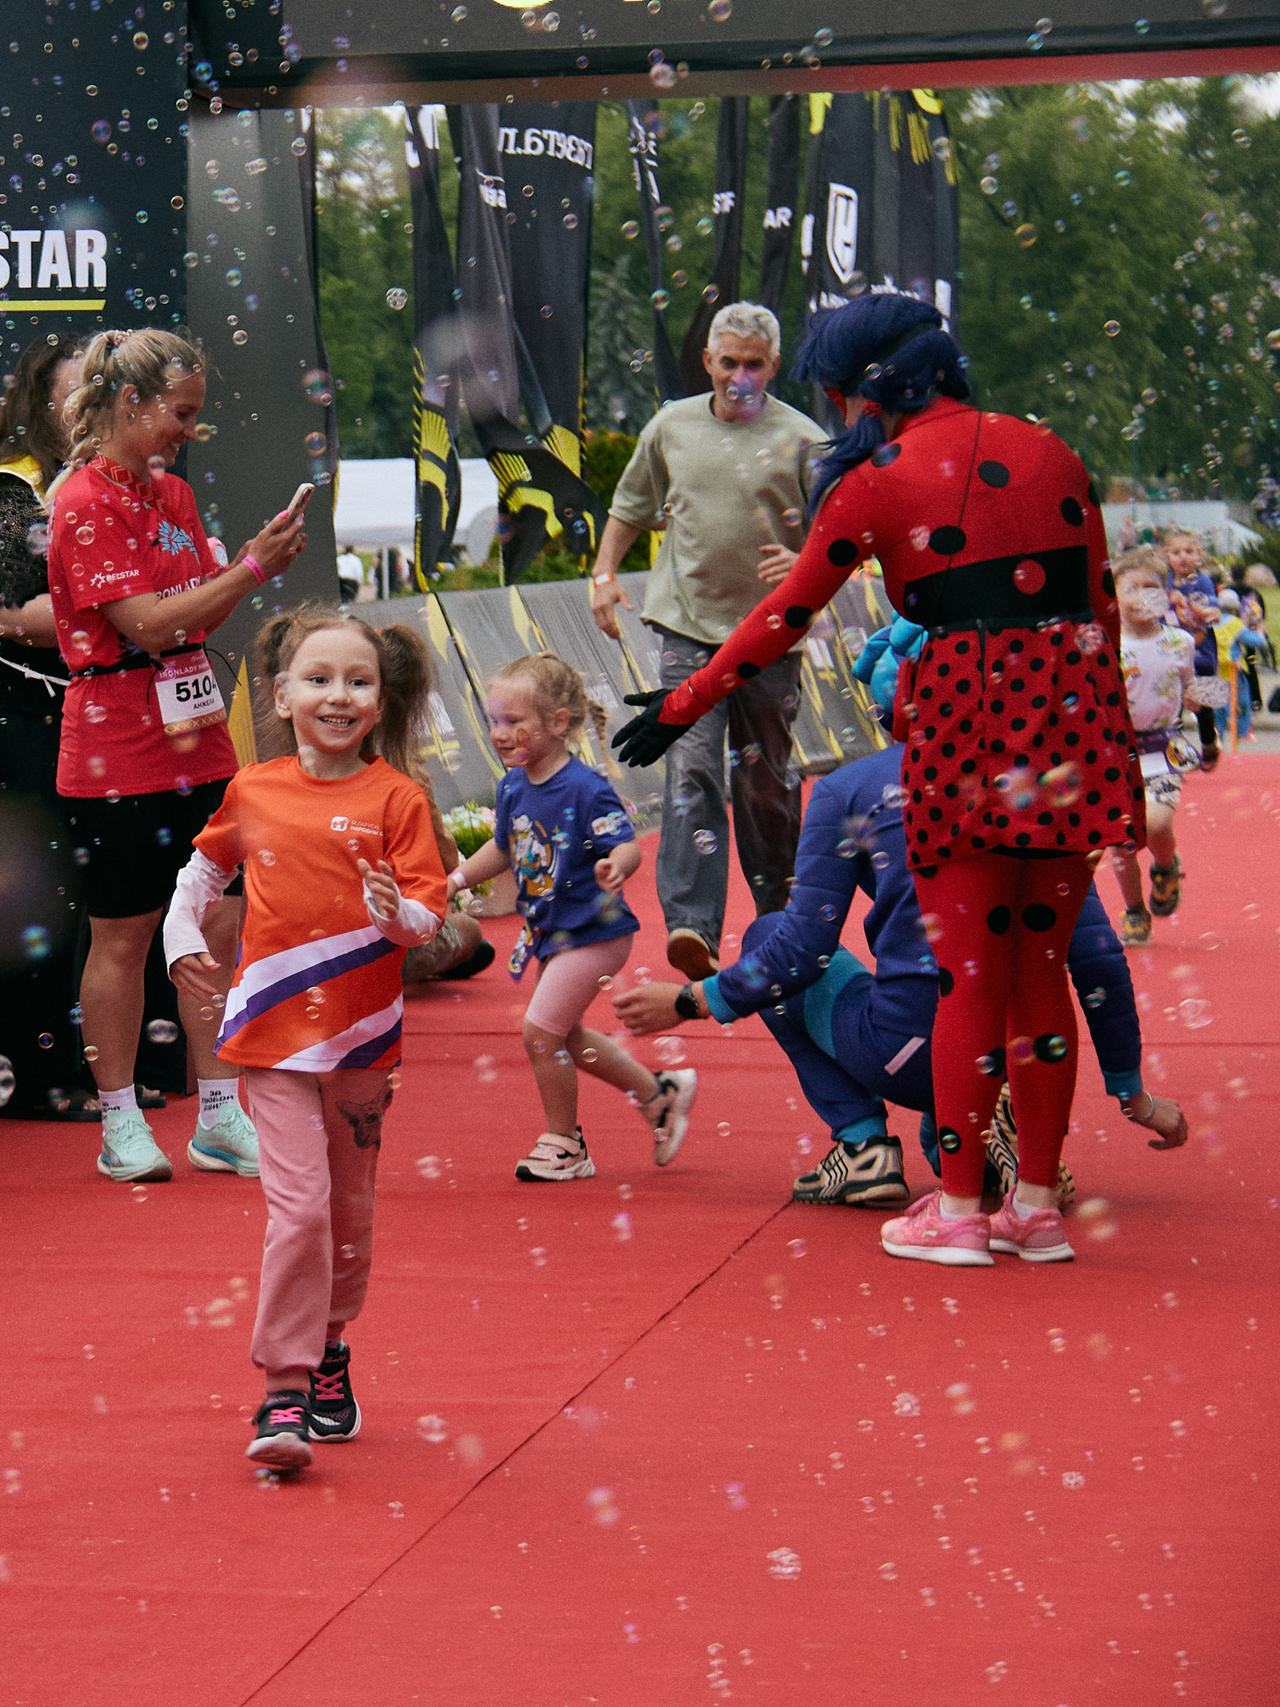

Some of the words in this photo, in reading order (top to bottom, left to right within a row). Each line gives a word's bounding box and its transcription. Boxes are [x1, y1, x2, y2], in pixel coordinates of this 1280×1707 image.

[106, 569, 140, 583] BELSTAR
[156, 575, 201, 600] RONLADY
[176, 674, 218, 702] 510
